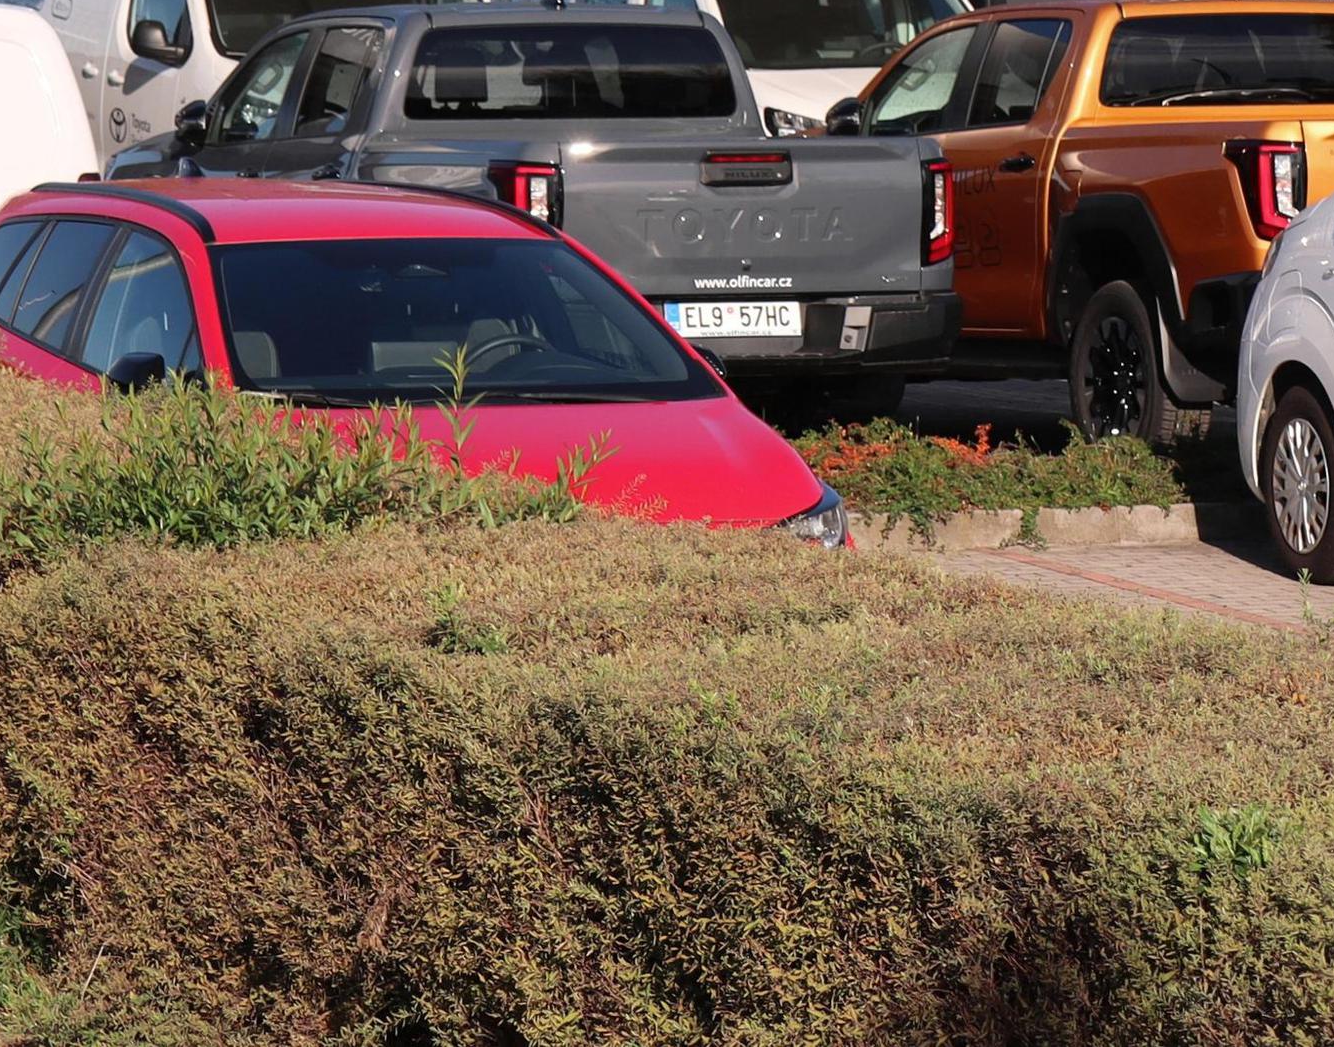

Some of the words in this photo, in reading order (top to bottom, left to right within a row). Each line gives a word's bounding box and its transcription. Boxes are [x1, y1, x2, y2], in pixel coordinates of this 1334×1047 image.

[636, 205, 854, 244] TOYOTA
[694, 276, 792, 289] www.olfincar.cz
[685, 307, 723, 328] EL9
[740, 306, 790, 328] 57HC
